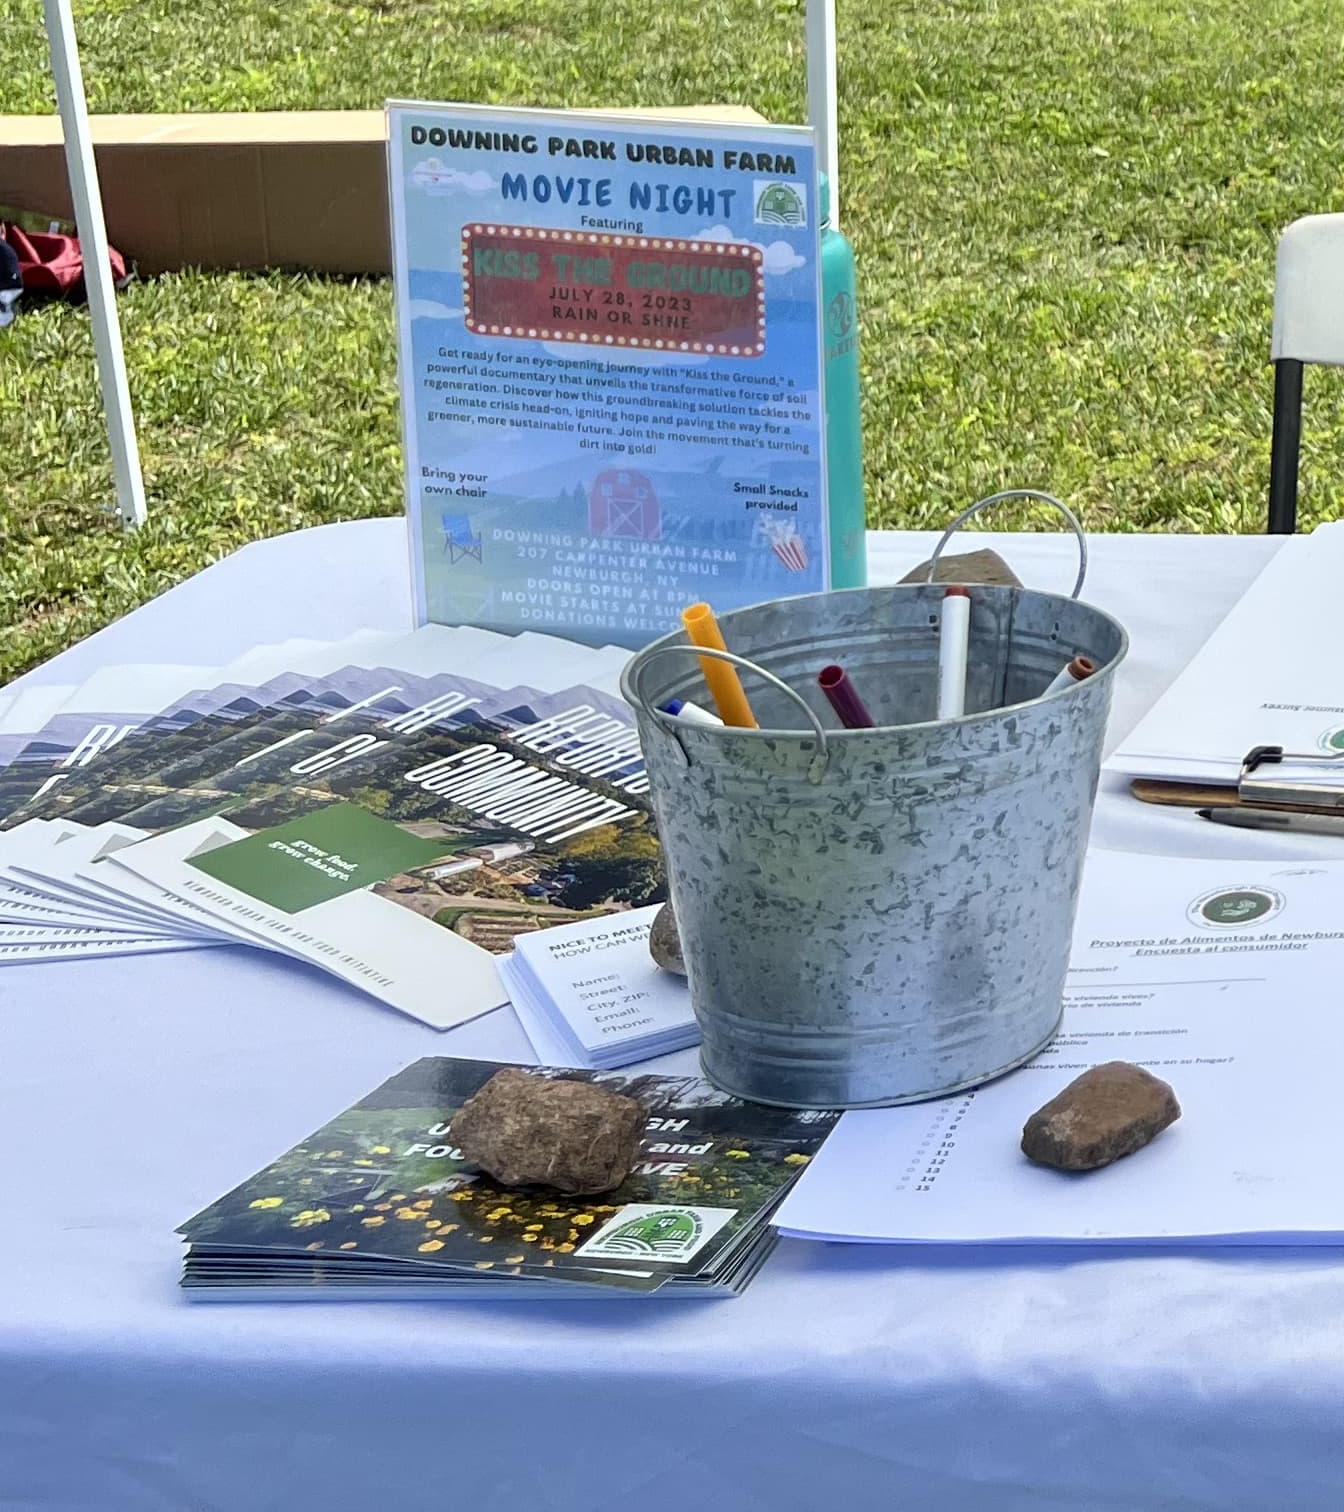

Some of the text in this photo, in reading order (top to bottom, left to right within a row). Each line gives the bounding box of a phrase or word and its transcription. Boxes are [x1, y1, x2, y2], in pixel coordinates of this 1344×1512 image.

[410, 125, 795, 174] DOWNING PARK URBAN FARM
[501, 171, 736, 218] MOVIE NIGHT
[580, 215, 643, 233] Featuring
[473, 247, 752, 298] KISS THE GROUND
[548, 286, 691, 312] JULY 28, 2023
[552, 305, 597, 320] RAIN
[606, 310, 632, 325] OR
[421, 466, 488, 483] Bring your
[424, 484, 487, 497] own chair
[733, 481, 808, 498] Small Snacks
[745, 500, 797, 511] provided
[404, 743, 639, 844] COMMUNITY
[268, 841, 306, 858] grow
[290, 840, 328, 857] grow
[549, 938, 585, 952] NICE
[589, 932, 609, 944] TO
[572, 973, 620, 989] Name:
[579, 984, 628, 1000] Street:
[594, 1007, 640, 1023] Email:
[601, 1017, 655, 1034] Phone:
